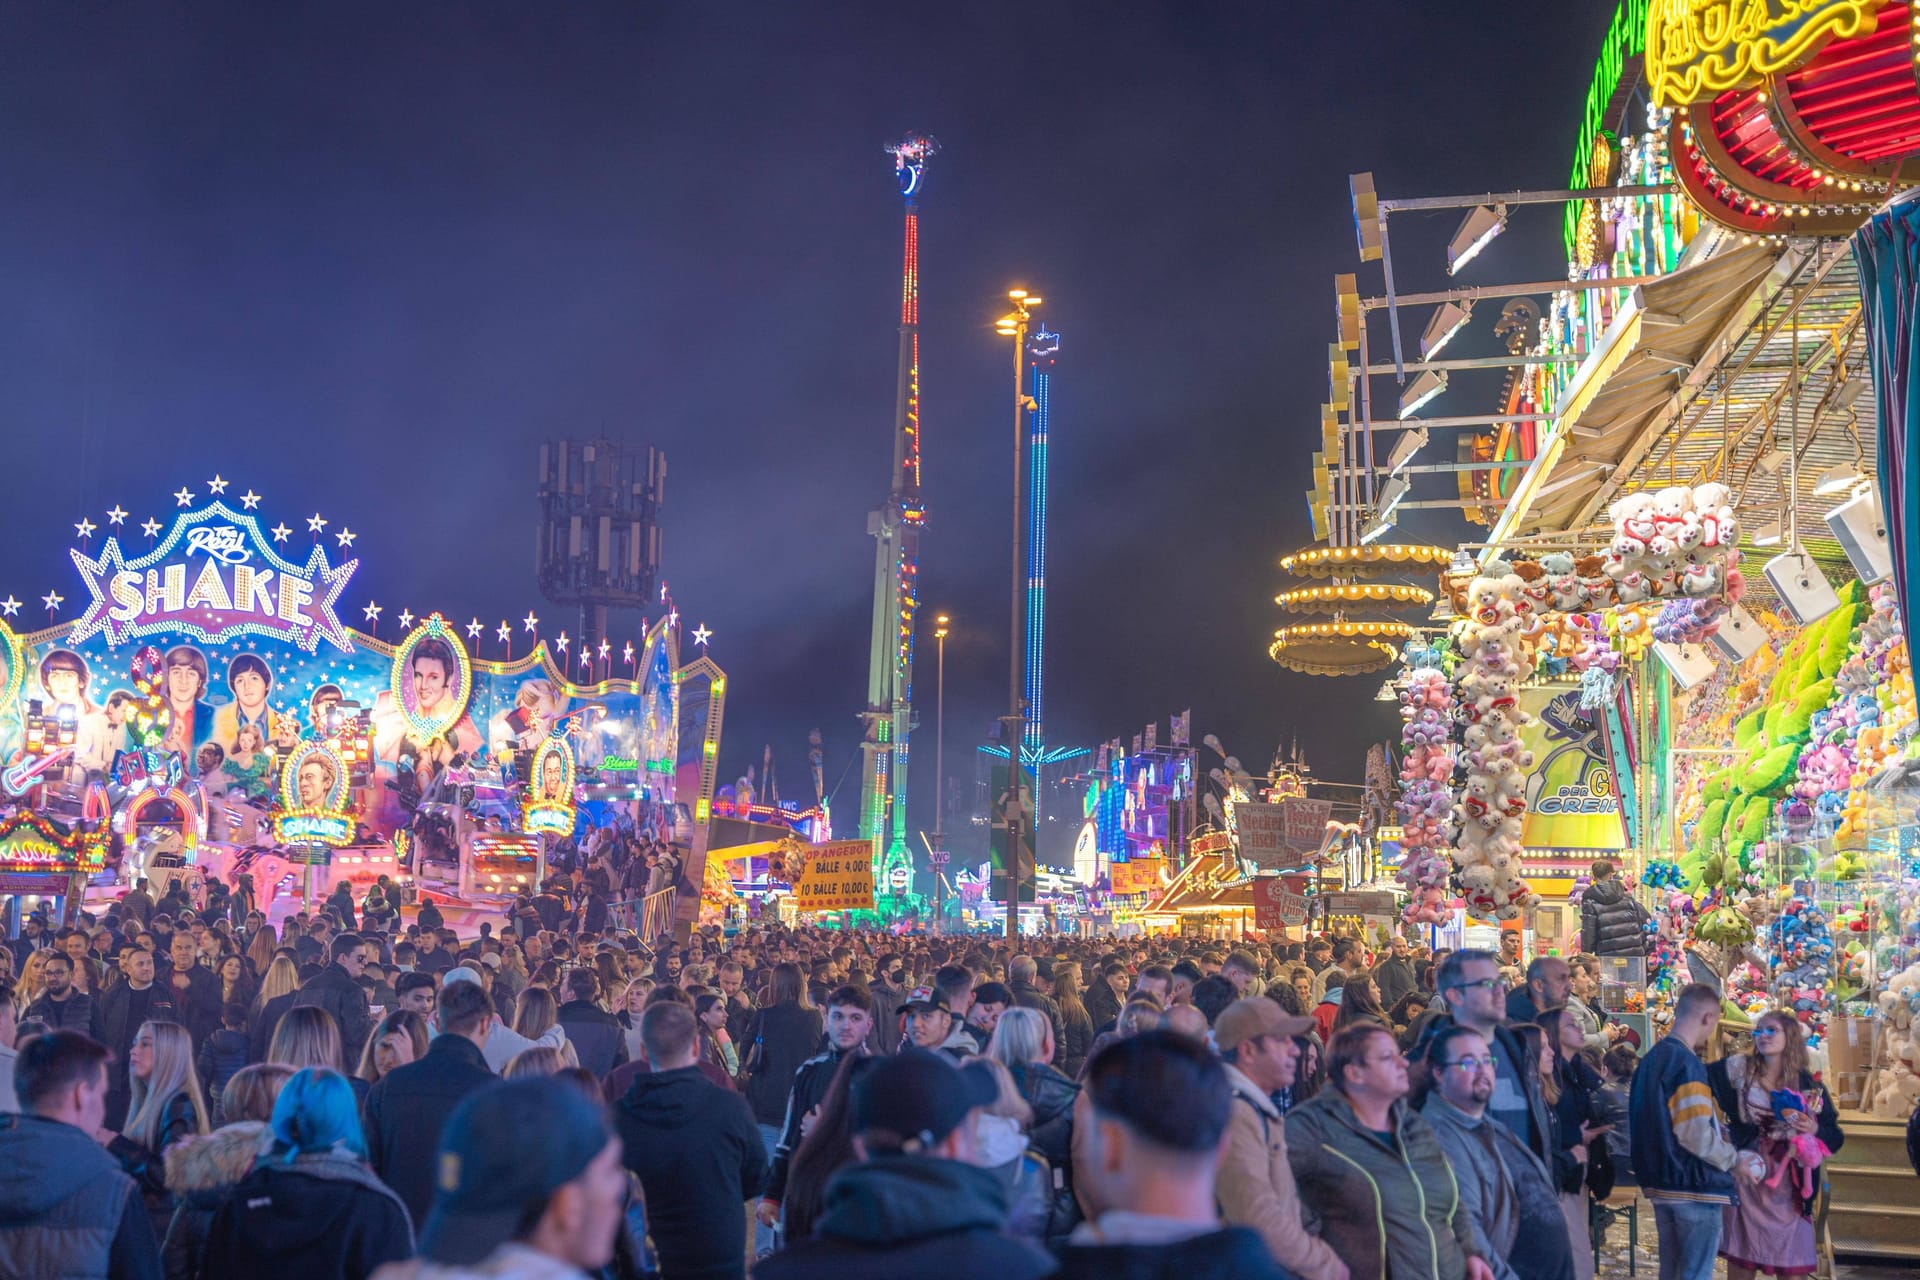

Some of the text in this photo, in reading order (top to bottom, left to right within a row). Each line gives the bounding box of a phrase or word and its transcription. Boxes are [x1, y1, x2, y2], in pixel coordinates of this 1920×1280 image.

[213, 526, 238, 539] The
[186, 526, 250, 563] Real
[108, 556, 314, 627] SHAKE
[1558, 786, 1589, 797] DER
[783, 801, 797, 810] WC
[1292, 802, 1322, 815] XXL
[281, 817, 347, 839] SHAKE
[805, 844, 871, 861] OP ANGEBOT
[934, 853, 949, 862] WC
[801, 884, 810, 896] 10
